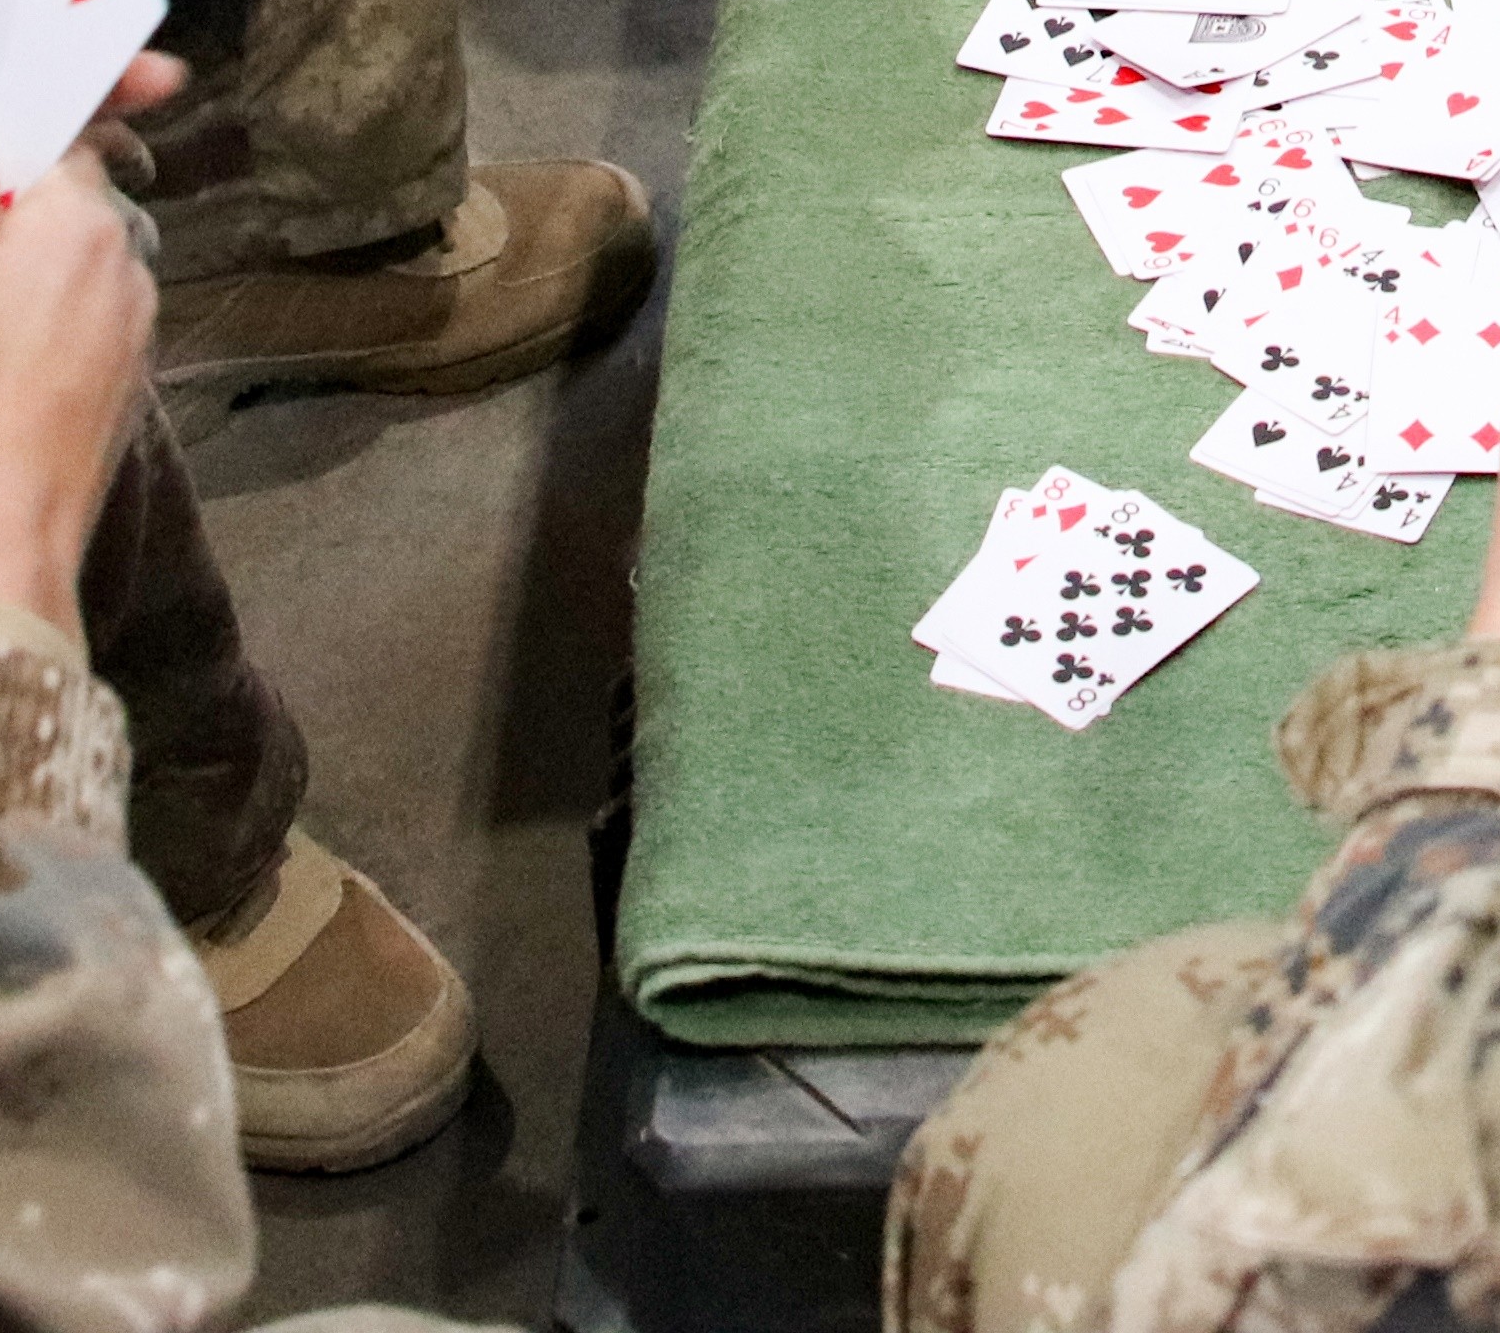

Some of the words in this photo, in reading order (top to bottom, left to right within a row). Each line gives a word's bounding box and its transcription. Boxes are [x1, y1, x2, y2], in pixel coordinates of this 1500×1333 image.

[1431, 26, 1452, 44] A
[1286, 130, 1313, 144] 6
[1258, 178, 1281, 196] 6
[1293, 198, 1316, 218] 6
[1319, 228, 1340, 248] 6
[1143, 255, 1172, 270] 6
[1362, 250, 1385, 266] 4
[1384, 305, 1400, 325] 4
[1328, 404, 1352, 421] 4
[1044, 477, 1071, 501] 8
[1336, 472, 1359, 492] 4
[1111, 502, 1140, 524] 8
[1400, 508, 1421, 528] 4
[1067, 688, 1097, 712] 8
